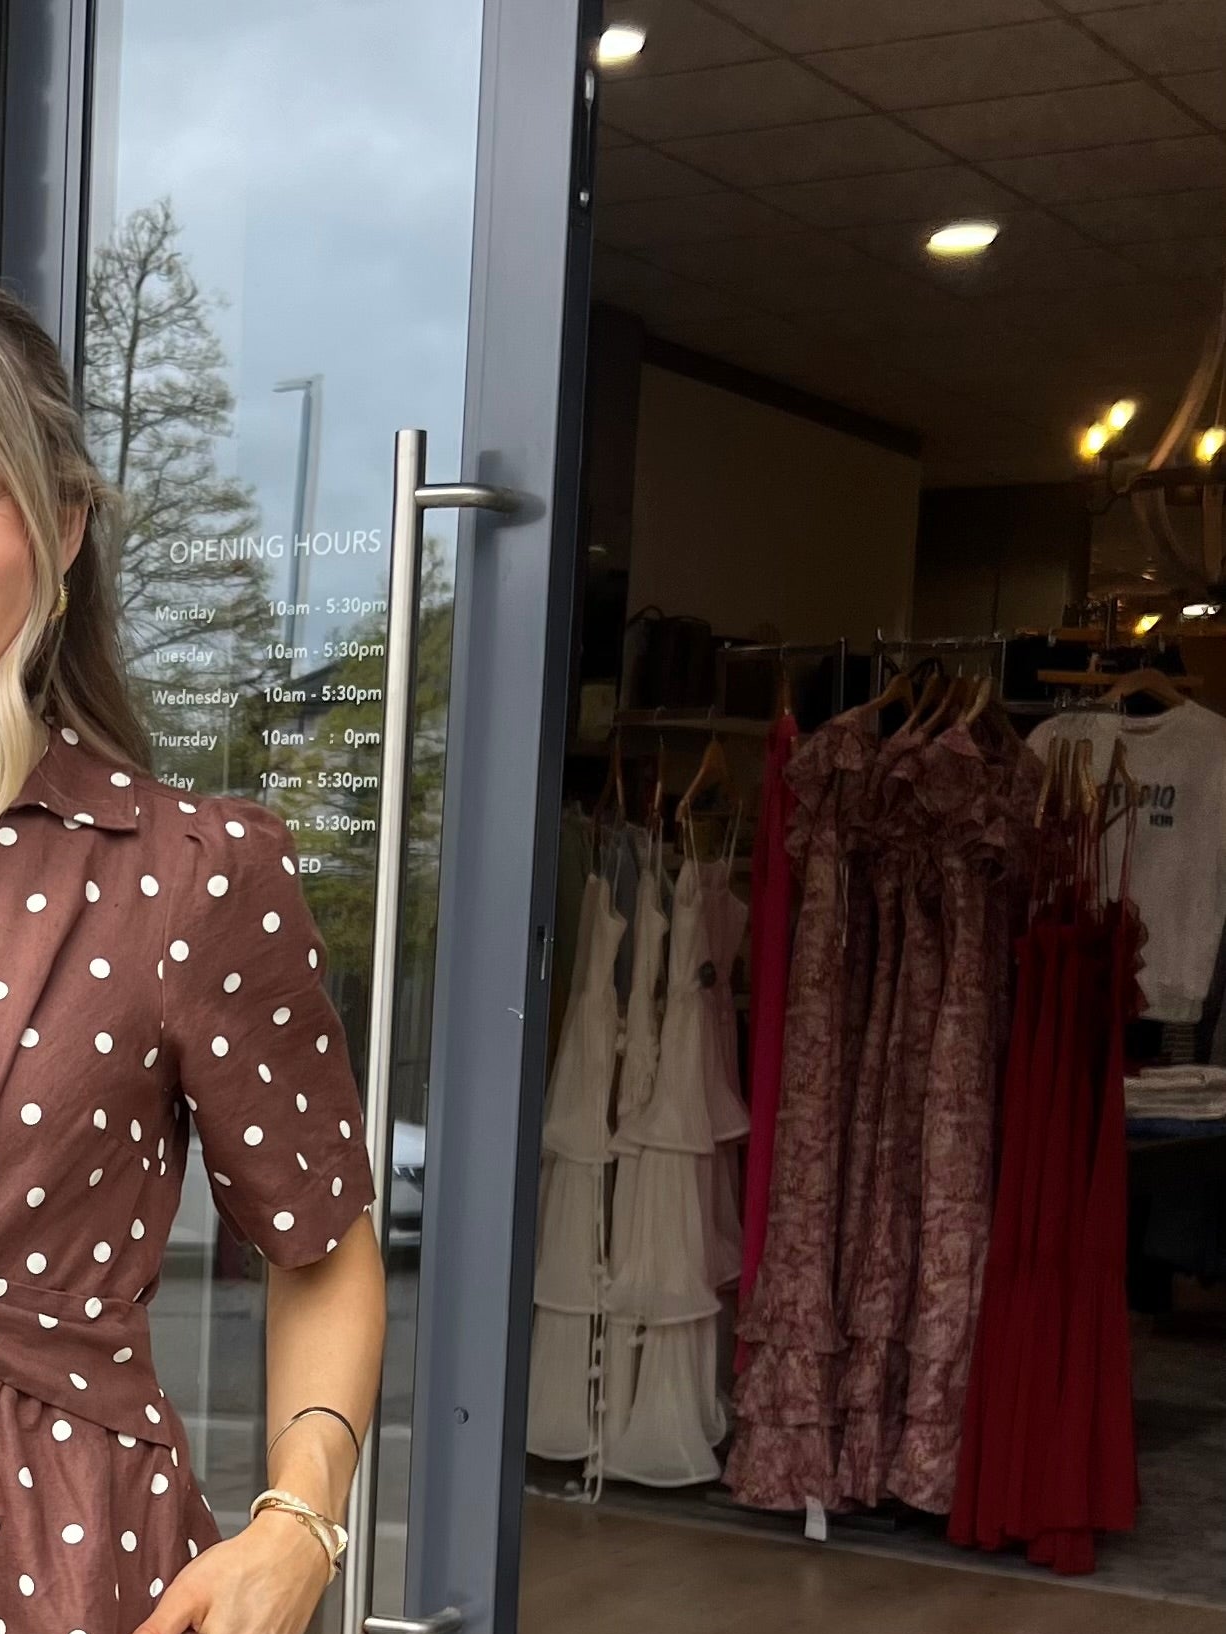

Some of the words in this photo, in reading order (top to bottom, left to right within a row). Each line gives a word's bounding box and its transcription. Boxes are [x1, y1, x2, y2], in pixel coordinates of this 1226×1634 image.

[169, 534, 284, 565] OPENING
[293, 529, 382, 557] HOURS
[154, 603, 216, 623] Monday
[268, 600, 310, 617] 10am
[325, 597, 387, 617] 5:30pm
[153, 648, 213, 667] Tuesday
[266, 644, 308, 660] 10am
[323, 641, 385, 660] 5:30pm
[151, 689, 239, 709] Wednesday
[264, 687, 306, 703] 10am
[321, 685, 383, 704] 5:30pm
[150, 731, 218, 750] Thursday
[261, 730, 304, 746] 10am
[157, 774, 195, 791] riday
[259, 772, 302, 789] 10am
[317, 771, 379, 791] 5:30pm
[315, 815, 376, 835] 5:30pm
